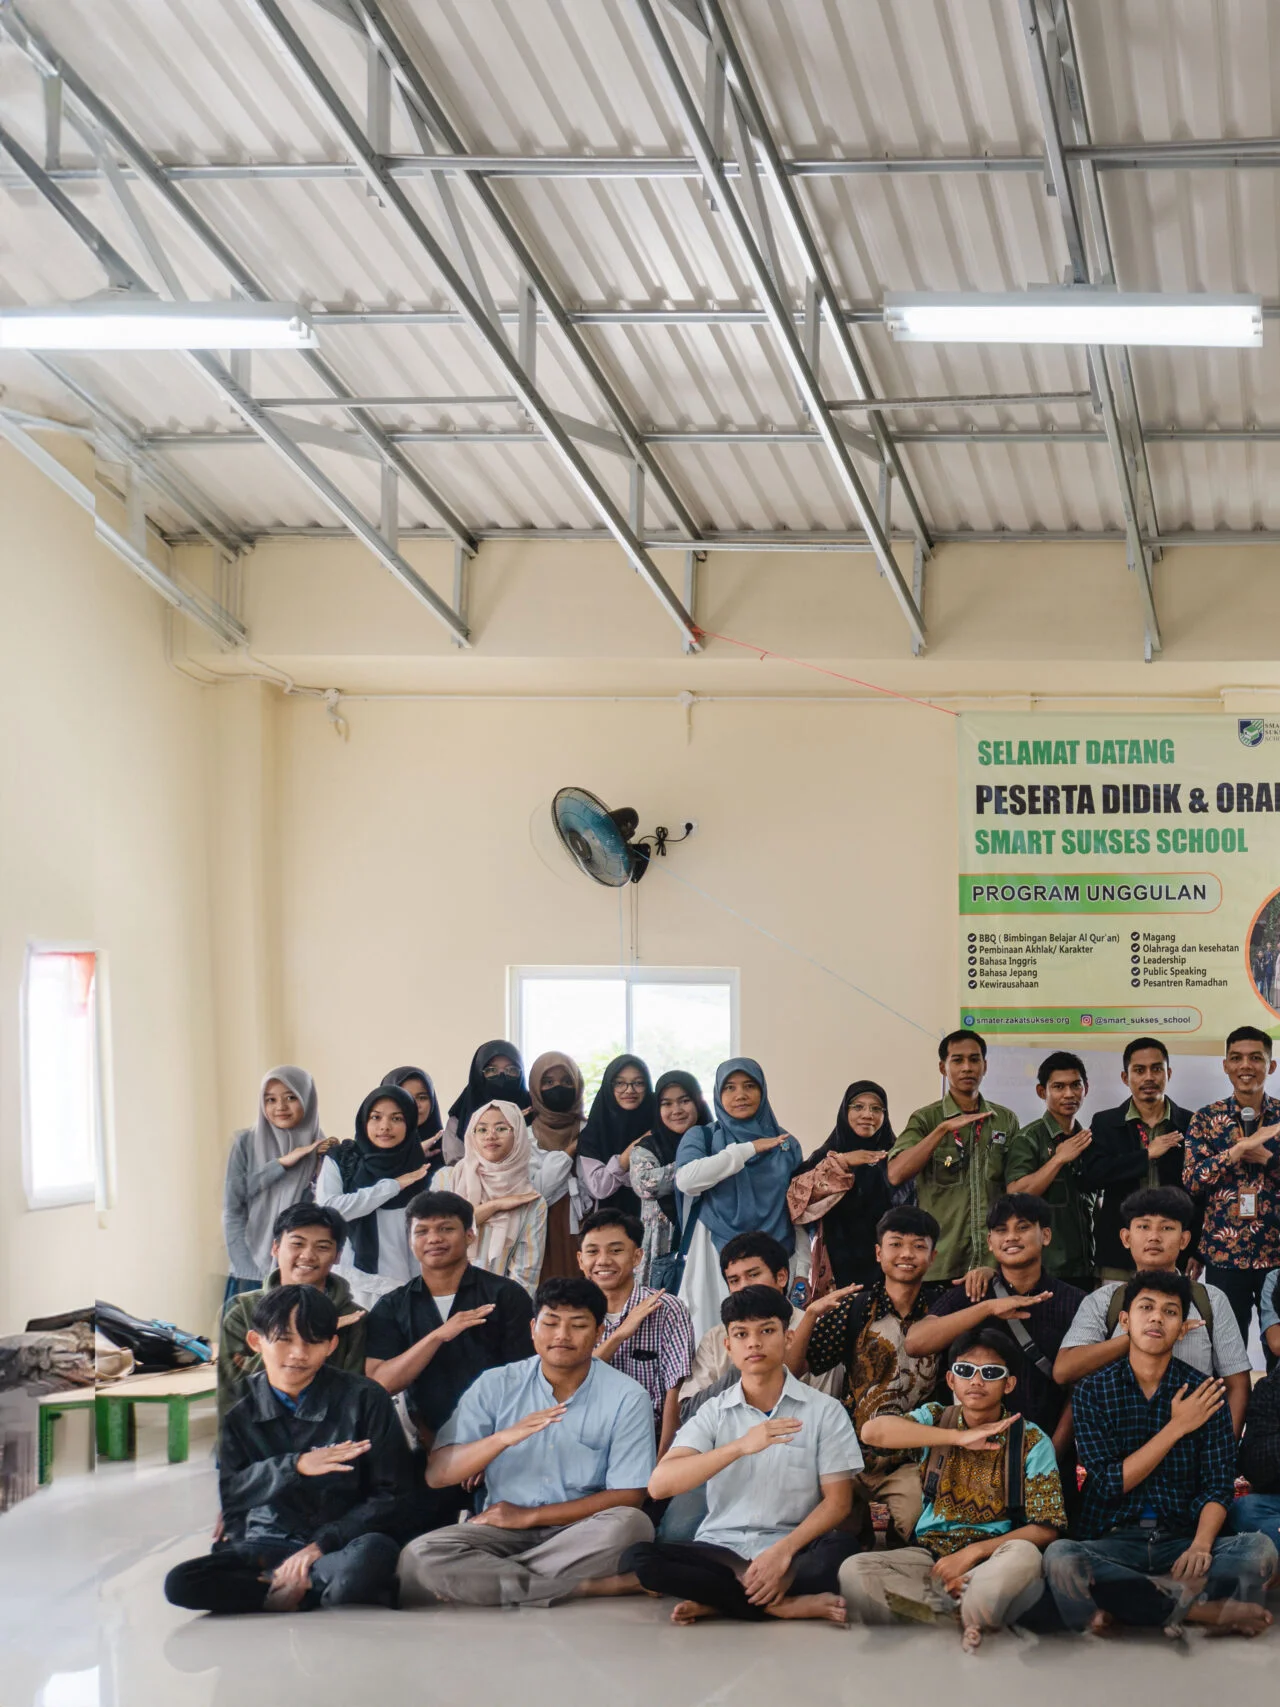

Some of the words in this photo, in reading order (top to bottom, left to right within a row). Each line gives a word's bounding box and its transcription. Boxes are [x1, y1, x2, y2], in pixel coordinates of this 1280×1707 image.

[977, 740, 1080, 766] SELAMAT
[1085, 739, 1175, 765] DATANG
[975, 784, 1096, 815] PESERTA
[1102, 783, 1182, 814] DIDIK
[1188, 787, 1210, 813] &
[974, 829, 1056, 855] SMART
[1061, 828, 1151, 854] SUKSES
[1156, 827, 1249, 854] SCHOOL
[972, 884, 1080, 902] PROGRAM
[1087, 884, 1207, 901] UNGGULAN
[979, 934, 997, 944] BBQ
[1003, 933, 1047, 944] Bimbingan
[1049, 933, 1077, 944] Belajar
[1079, 933, 1088, 942] Al
[1143, 932, 1176, 943] Magang
[979, 945, 1023, 954] Pembinaan
[1025, 944, 1056, 954] Akhlak/
[1059, 945, 1093, 954] Karakter
[1143, 944, 1179, 954] Olahraga
[1181, 944, 1197, 952] dan
[1199, 944, 1239, 952] kesehatan
[979, 957, 1007, 966] Bahasa
[1008, 956, 1037, 967] Inggris
[1143, 955, 1186, 966] Leadership
[979, 968, 1007, 977] Bahasa
[1009, 968, 1038, 979] Jepang
[1143, 967, 1168, 975] Public
[1170, 966, 1207, 977] Speaking
[979, 979, 1039, 988] Kewirausahaan
[1143, 978, 1183, 987] Pesantren
[1185, 978, 1228, 987] Ramadhan
[976, 1016, 1070, 1025] smater.zakatsukses.org
[1095, 1016, 1191, 1026] @smart_sukses_school
